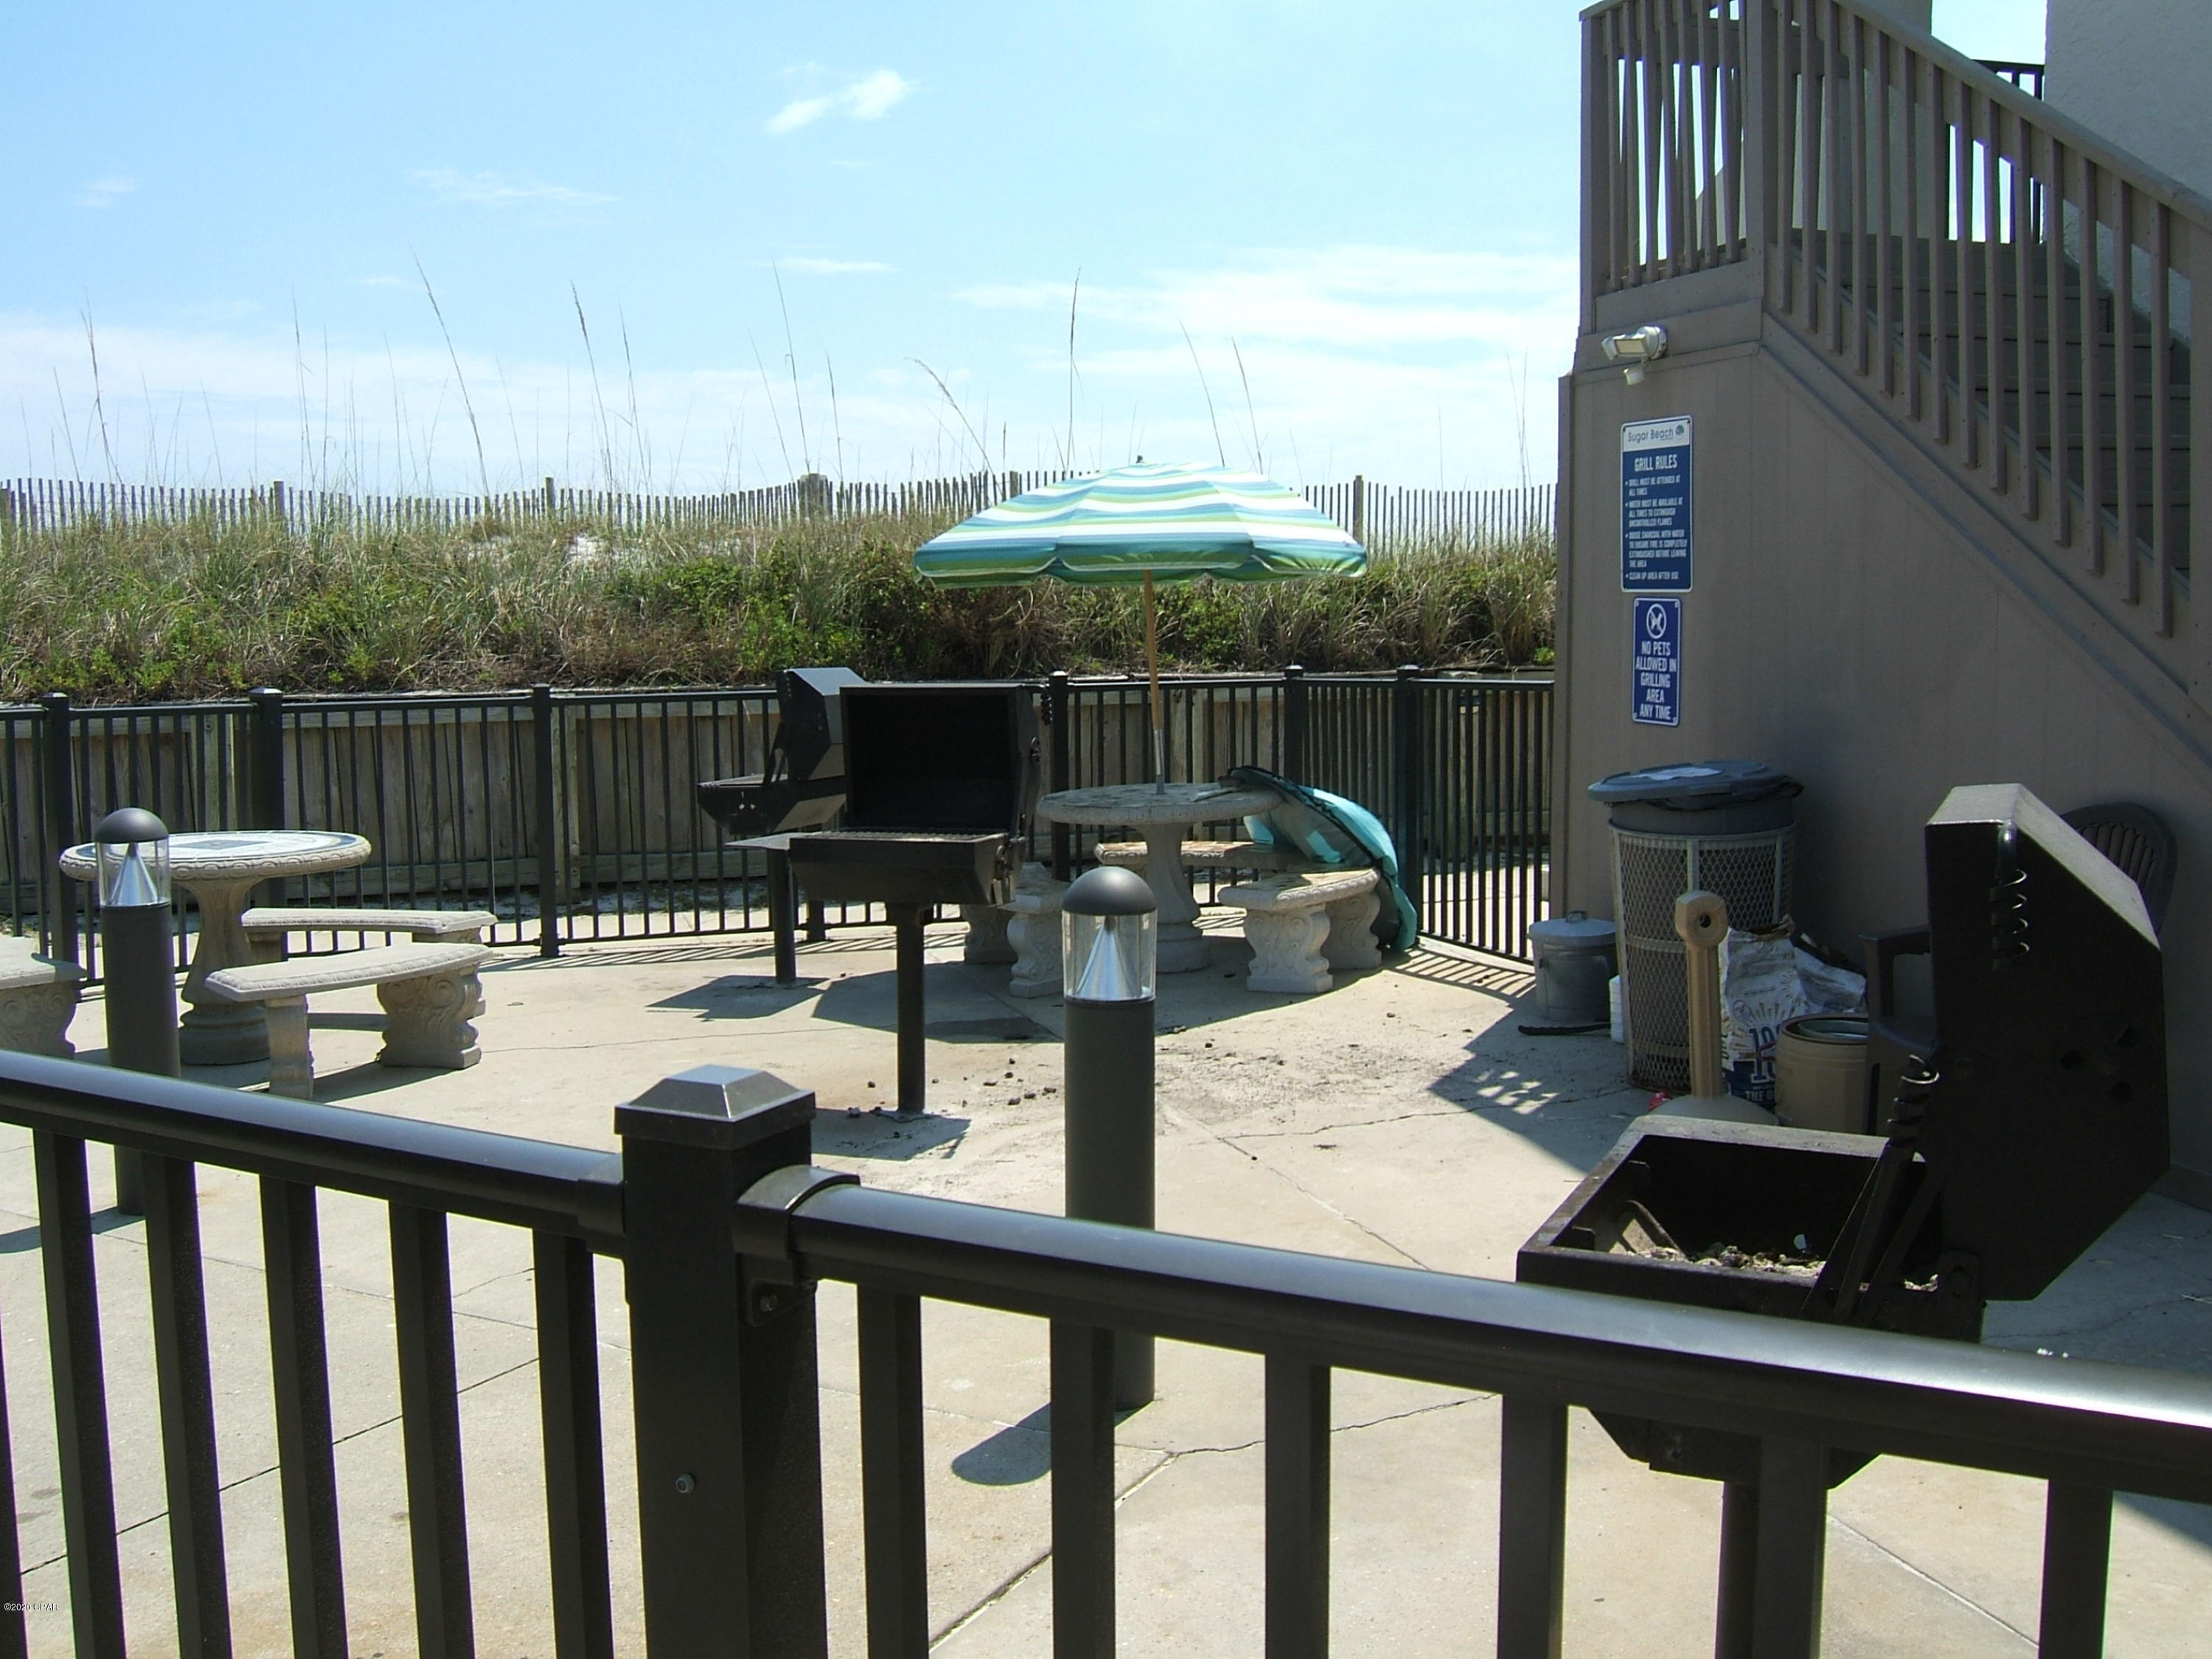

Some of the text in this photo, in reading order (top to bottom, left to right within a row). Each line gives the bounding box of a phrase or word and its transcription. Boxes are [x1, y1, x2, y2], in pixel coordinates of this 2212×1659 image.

[1628, 428, 1673, 443] Sugar Beach
[1635, 454, 1677, 472] GRILL RULES
[1636, 487, 1647, 495] TIMES
[1636, 509, 1647, 518] TIMES
[1648, 509, 1653, 517] TO
[1657, 518, 1672, 526] FLAMES
[1641, 641, 1671, 656] NO PETS
[1635, 656, 1677, 672] ALLOWED IN
[1641, 672, 1671, 688] GRILLING
[1646, 689, 1665, 703] AREA
[1640, 703, 1672, 720] ANY TIME
